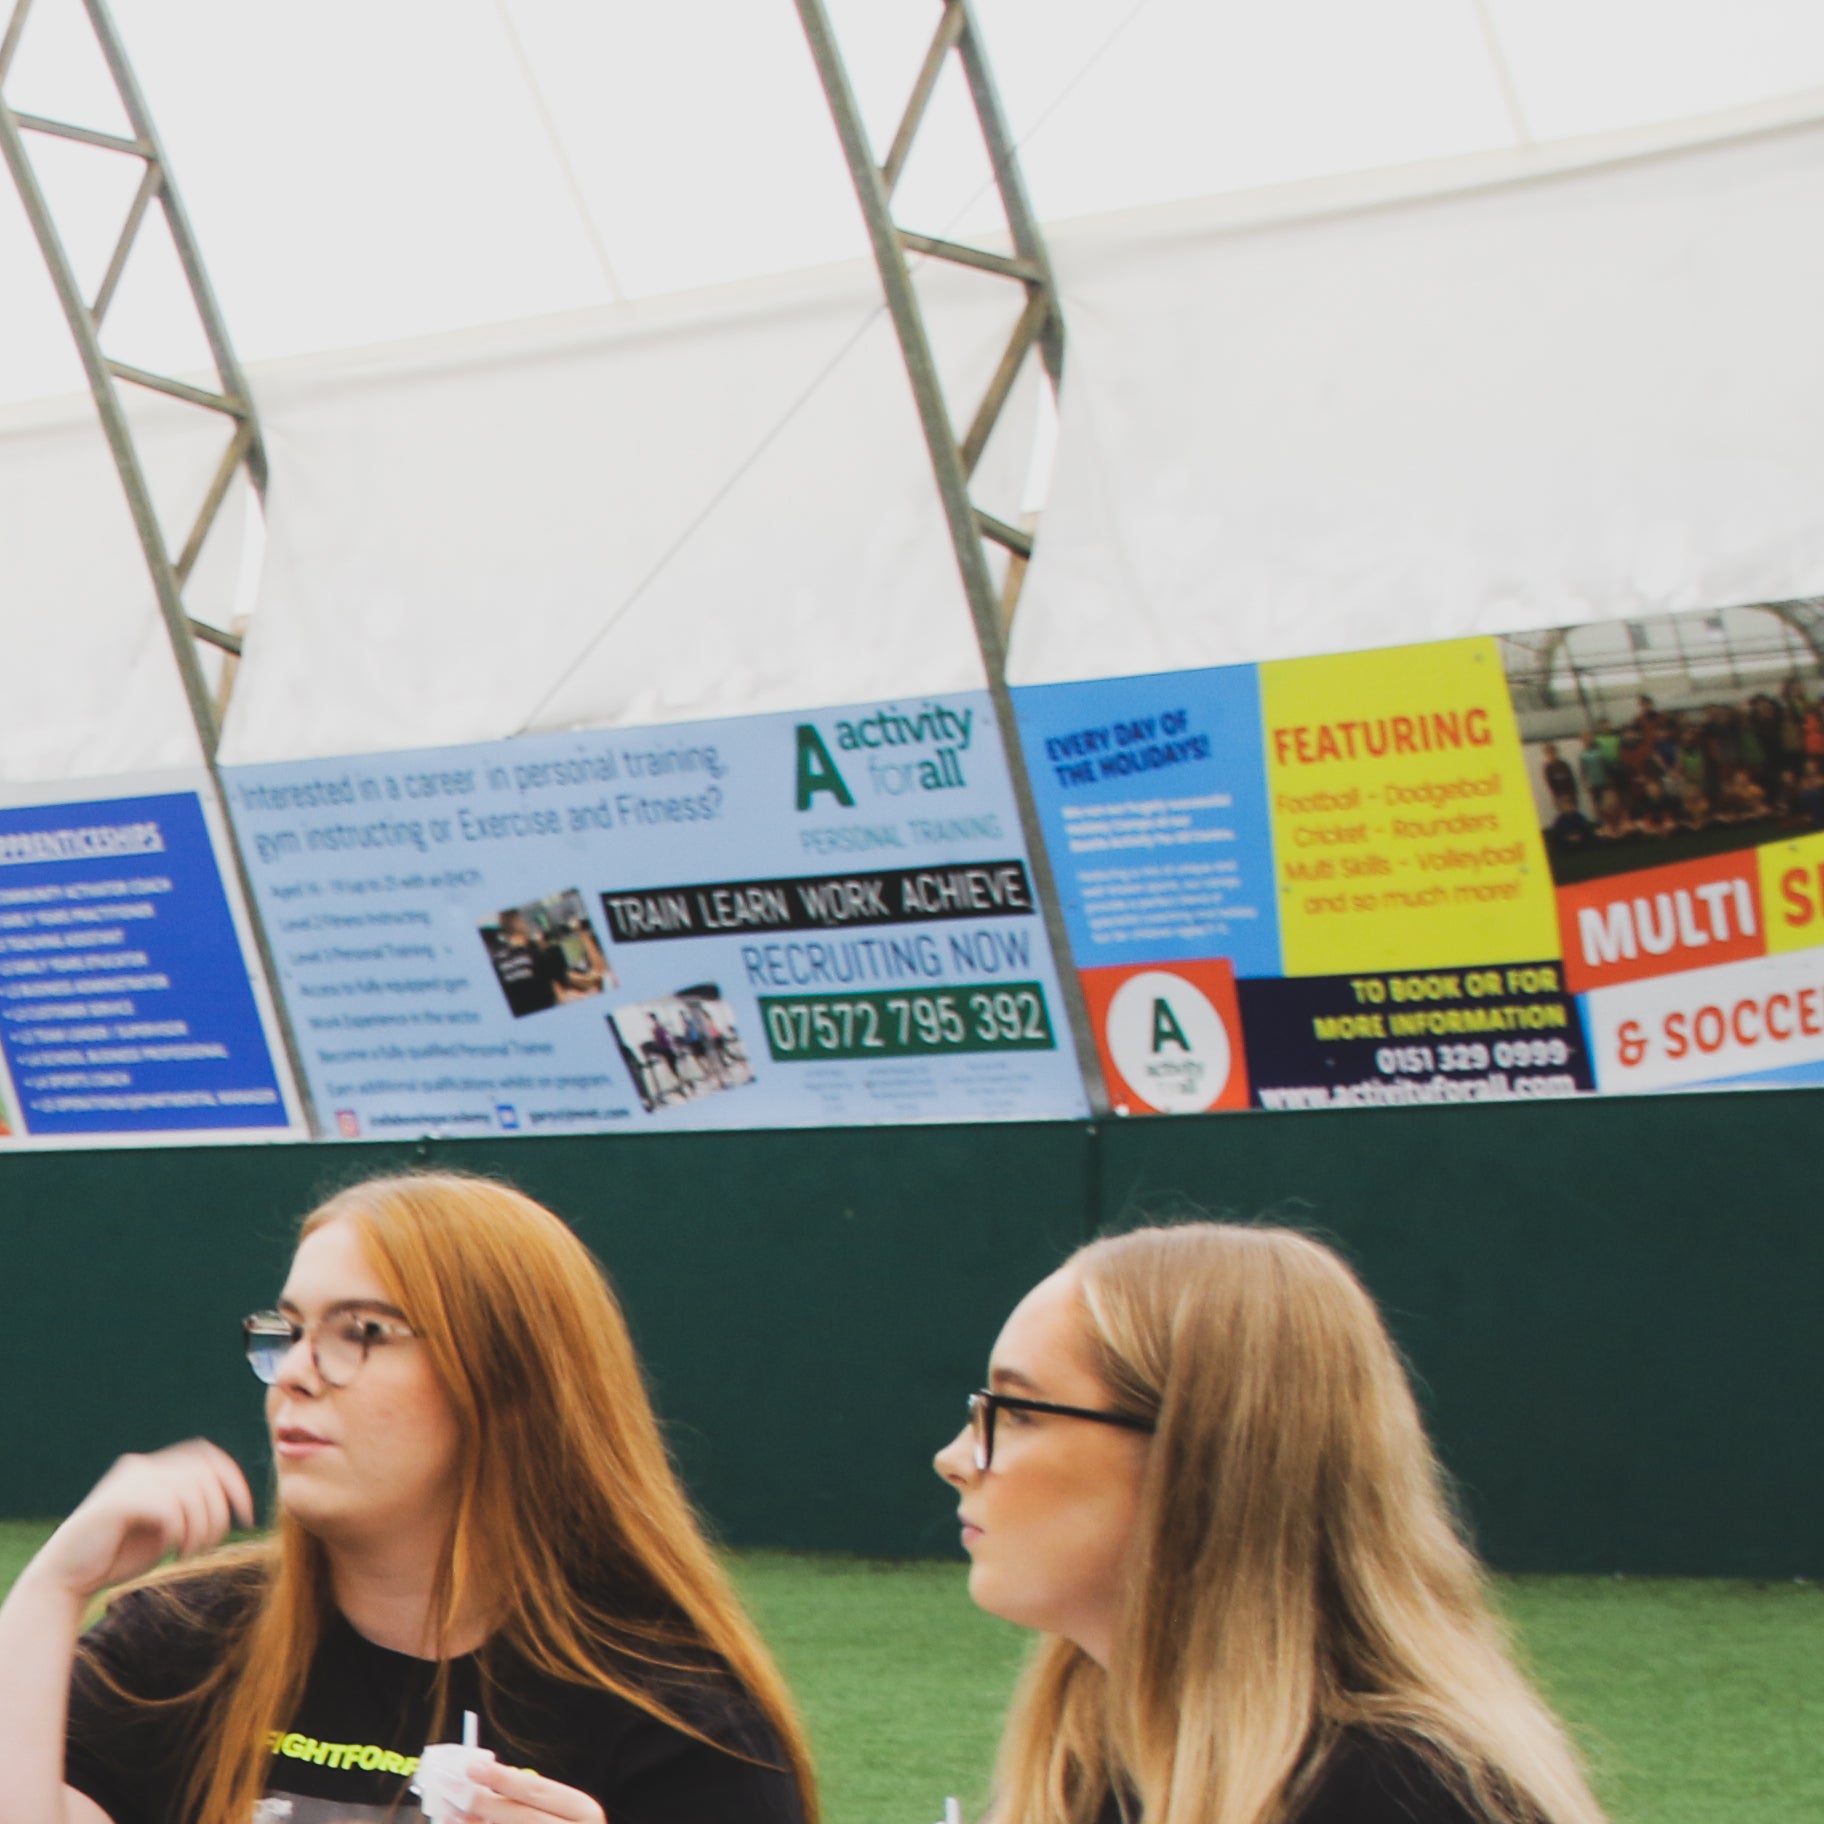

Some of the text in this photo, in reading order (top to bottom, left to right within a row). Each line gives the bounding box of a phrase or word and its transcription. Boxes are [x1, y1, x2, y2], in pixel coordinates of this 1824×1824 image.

[834, 701, 972, 750] activity
[1045, 708, 1188, 762] EVERY DAY OF
[1274, 708, 1492, 766] FEATURING
[511, 750, 621, 794] personal
[796, 725, 855, 811] A
[1055, 759, 1097, 789] THE
[456, 801, 563, 841] Exercise
[564, 799, 613, 831] and
[610, 894, 692, 937] TRAIN
[698, 886, 789, 929] LEARN
[797, 879, 889, 924] WORK
[901, 868, 1025, 914] ACHIEVE
[1578, 862, 1824, 967] MULTI S
[742, 929, 1031, 987] RECRUITING NOW
[1351, 967, 1559, 1004] TO BOOK OR FOR
[768, 991, 1045, 1051] 07572 795 392
[1152, 998, 1190, 1053] A
[1313, 1003, 1569, 1042] MORE INFORMATION
[1617, 985, 1824, 1067] & SOCCE
[1375, 1045, 1436, 1074] 0151
[1437, 1042, 1490, 1071] 329
